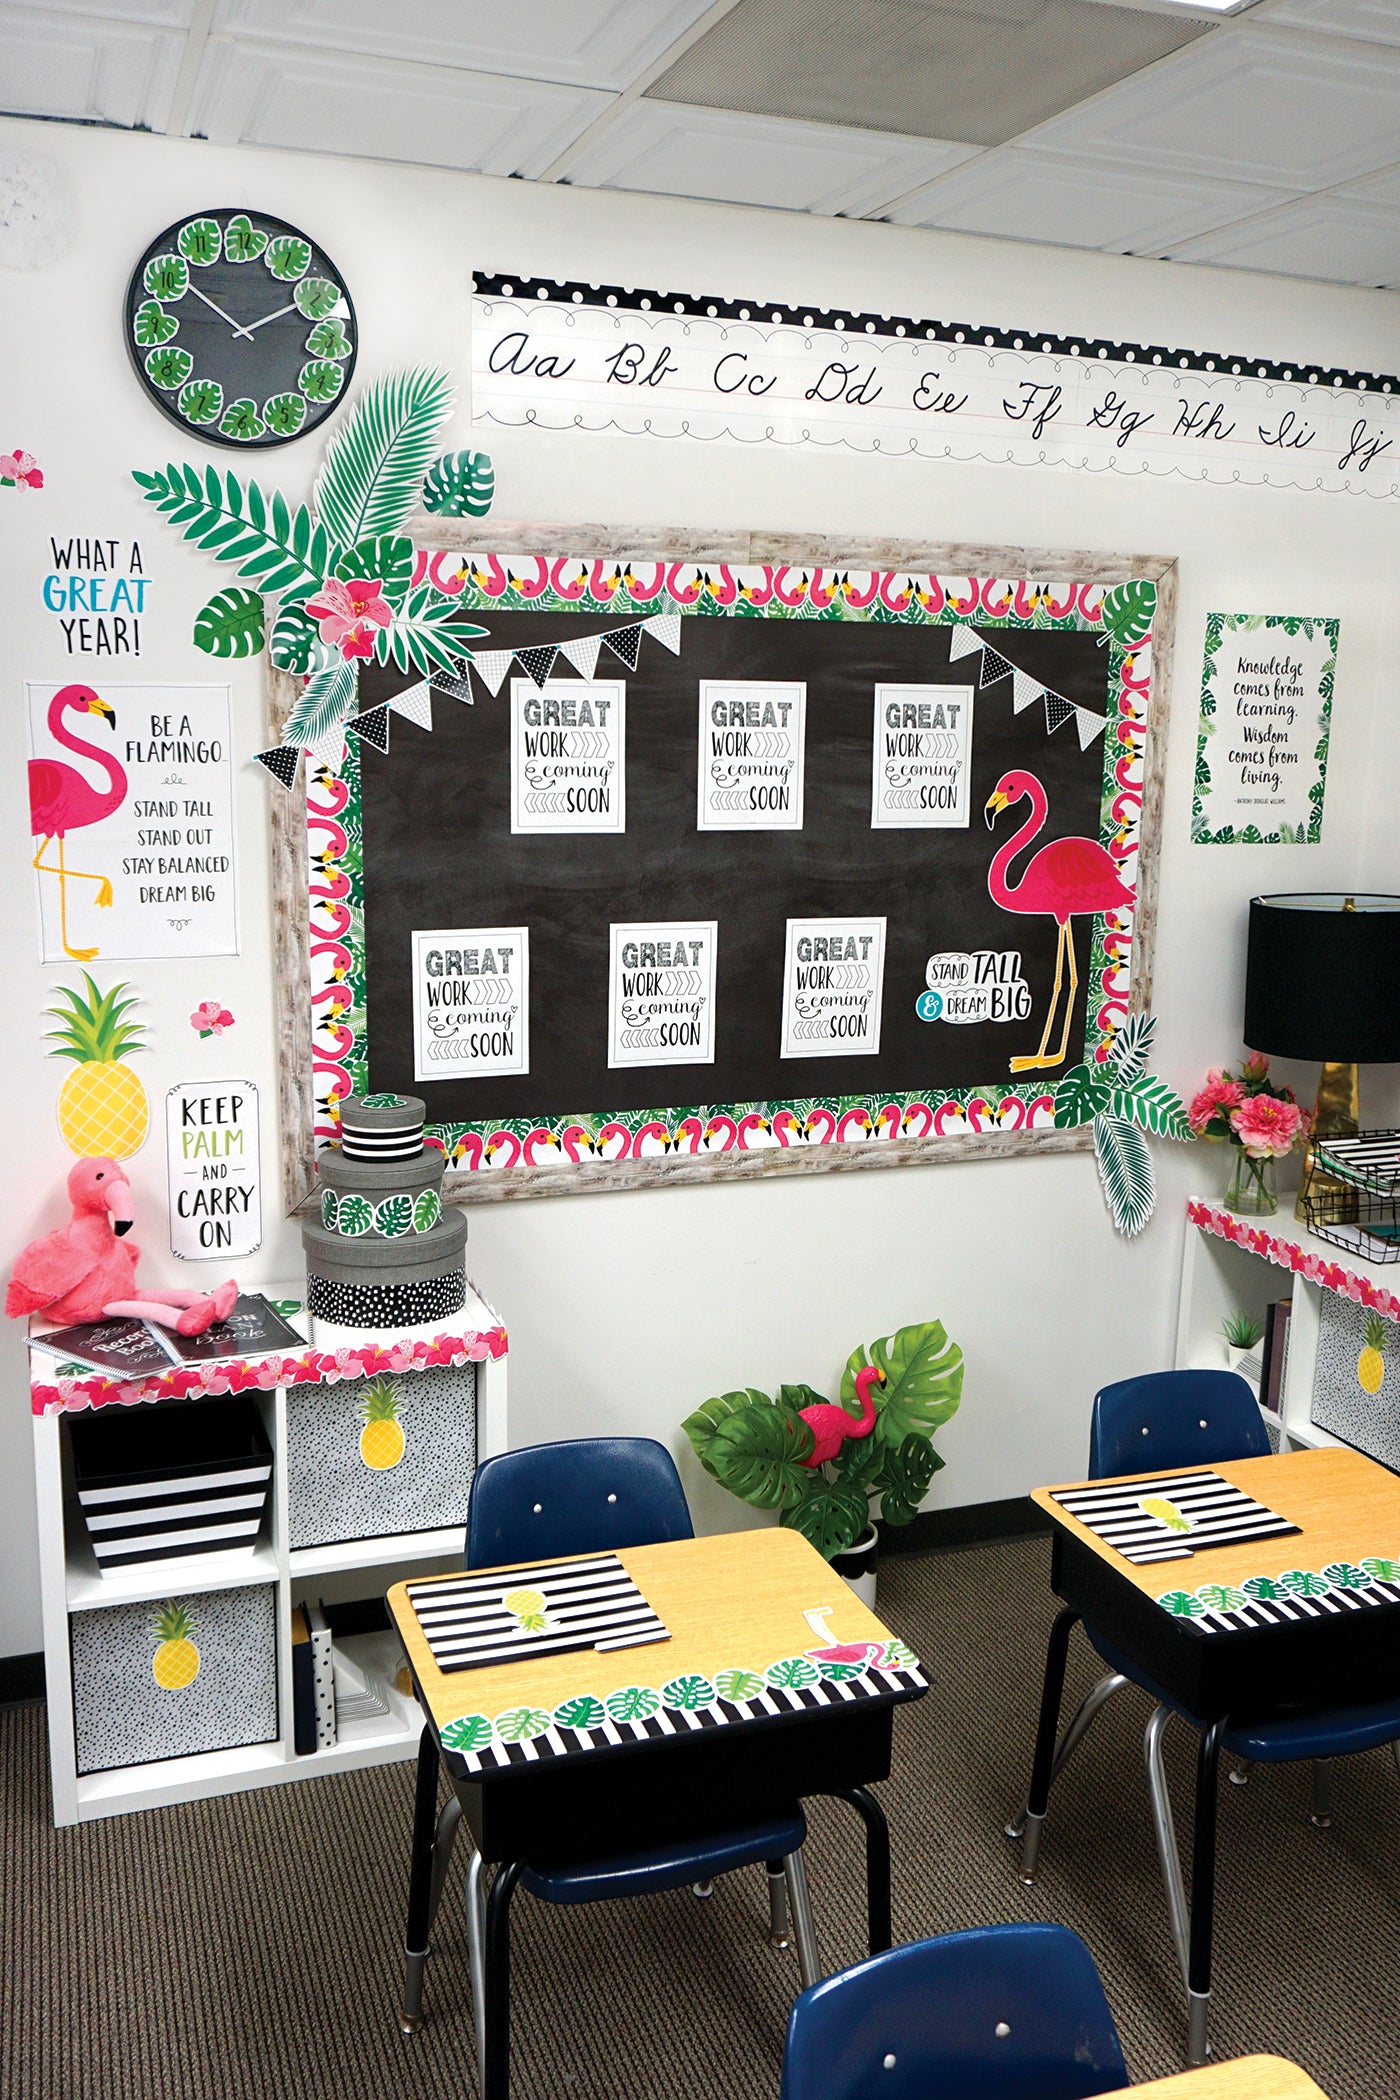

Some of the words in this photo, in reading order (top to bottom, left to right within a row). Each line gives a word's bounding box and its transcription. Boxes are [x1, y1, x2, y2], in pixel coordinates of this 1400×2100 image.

[194, 236, 206, 252] 11
[237, 232, 251, 250] 12
[283, 251, 292, 267] 1
[160, 271, 175, 289] 10
[309, 291, 321, 308] 2
[151, 317, 159, 334] 9
[324, 333, 335, 349] 3
[161, 361, 173, 377] 8
[316, 375, 326, 390] 4
[197, 396, 206, 412] 7
[489, 332, 576, 378] Aa
[605, 343, 678, 387] Bb
[713, 353, 777, 396] Cc
[805, 362, 883, 405] Dd
[912, 372, 968, 413] Ee
[1002, 382, 1063, 440] Ff
[1086, 391, 1155, 448] Gg
[1172, 399, 1236, 441] Hh
[1258, 411, 1315, 449] Ii
[1338, 419, 1393, 472] Jj
[237, 415, 248, 430] 6
[280, 407, 289, 424] 5
[50, 537, 120, 572] WHAT
[129, 541, 143, 574] A
[43, 574, 153, 614] GREAT
[59, 616, 141, 657] YEAR!
[1237, 656, 1304, 685] Knowledge
[1233, 681, 1270, 697] comes
[1273, 677, 1304, 700] from
[523, 699, 611, 727] GREAT
[711, 700, 792, 728] GREAT
[886, 702, 961, 729] GREAT
[1236, 697, 1298, 725] learning.
[151, 715, 173, 737] BE
[179, 715, 193, 737] A
[1243, 723, 1289, 744] Wisdom
[524, 731, 570, 758] WORK
[711, 731, 753, 757] WORK
[885, 733, 925, 758] WORK
[1228, 749, 1265, 764] comes
[1268, 745, 1299, 768] from
[543, 761, 610, 786] coming
[728, 760, 792, 785] coming
[900, 761, 959, 785] coming
[1240, 766, 1283, 792] living.
[134, 800, 178, 818] STAND
[182, 800, 214, 817] TALL
[566, 787, 610, 813] SOON
[749, 785, 790, 811] SOON
[920, 785, 958, 809] SOON
[137, 829, 181, 846] STAND
[186, 828, 213, 845] OUT
[122, 857, 157, 874] STAY
[158, 855, 230, 873] BALANCED
[139, 885, 187, 904] DREAM
[191, 884, 216, 902] BIG
[621, 941, 703, 968] GREAT
[797, 936, 873, 962] GREAT
[425, 948, 514, 977] GREAT
[931, 963, 969, 980] STAND
[972, 953, 1021, 984] TALL
[622, 972, 664, 997] WORK
[797, 965, 835, 990] WORK
[427, 980, 472, 1007] WORK
[810, 992, 868, 1014] coming
[923, 995, 939, 1017] &
[947, 996, 987, 1015] DREAM
[991, 986, 1031, 1019] BIG
[446, 1008, 514, 1031] coming
[638, 998, 702, 1021] coming
[659, 1022, 701, 1047] SOON
[830, 1014, 868, 1039] SOON
[470, 1031, 514, 1058] SOON
[182, 1095, 243, 1126] KEEP
[182, 1129, 243, 1159] PALM
[202, 1163, 228, 1181] AND
[177, 1185, 255, 1218] CARRY
[200, 1220, 232, 1249] ON
